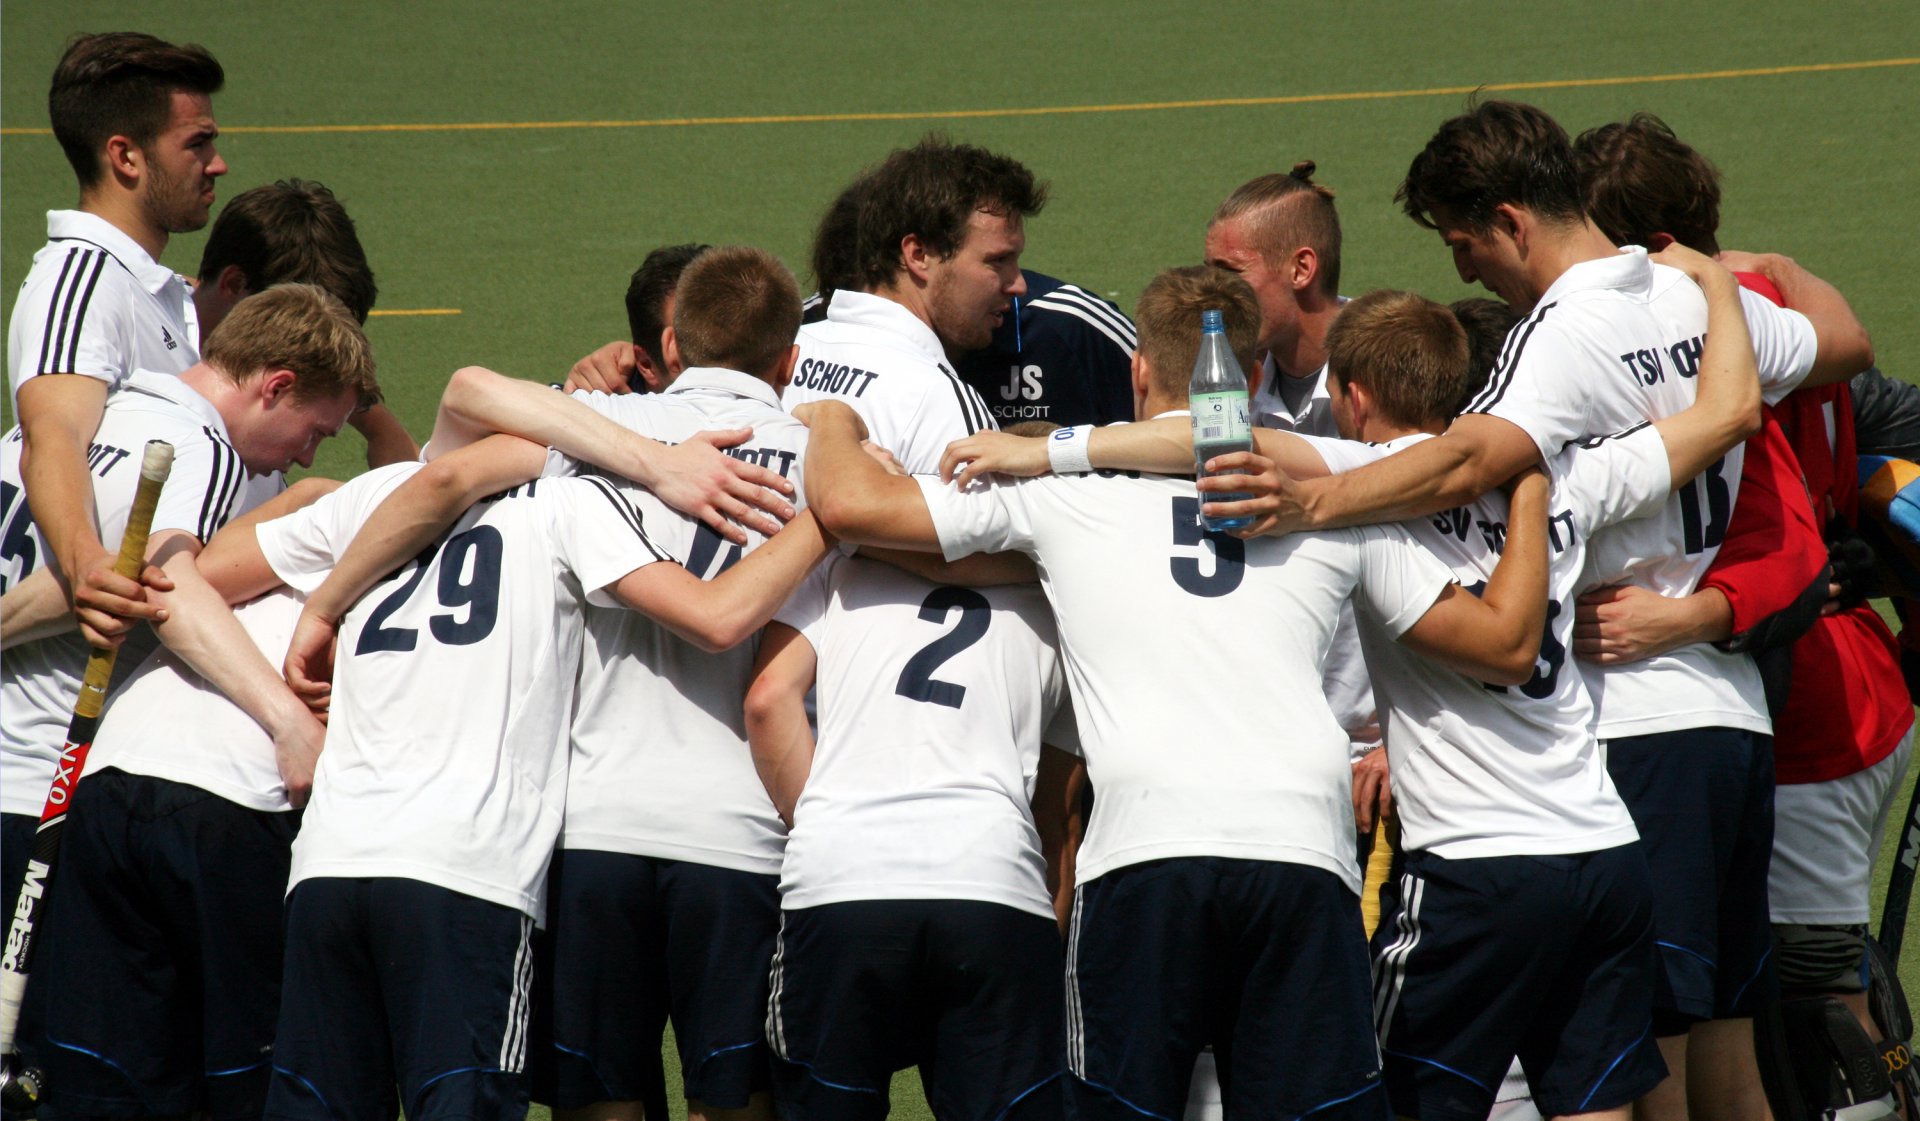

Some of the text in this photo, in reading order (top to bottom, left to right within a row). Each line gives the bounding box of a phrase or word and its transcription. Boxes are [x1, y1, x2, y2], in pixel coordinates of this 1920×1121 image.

[794, 358, 879, 398] SCHOTT
[1000, 365, 1043, 401] JS
[1620, 347, 1665, 387] TSV
[993, 405, 1051, 418] SCHOTT
[1170, 497, 1246, 598] 5
[354, 524, 503, 656] 29
[895, 586, 992, 710] 2
[49, 740, 80, 805] NXO
[18, 935, 31, 970] HOCKEY
